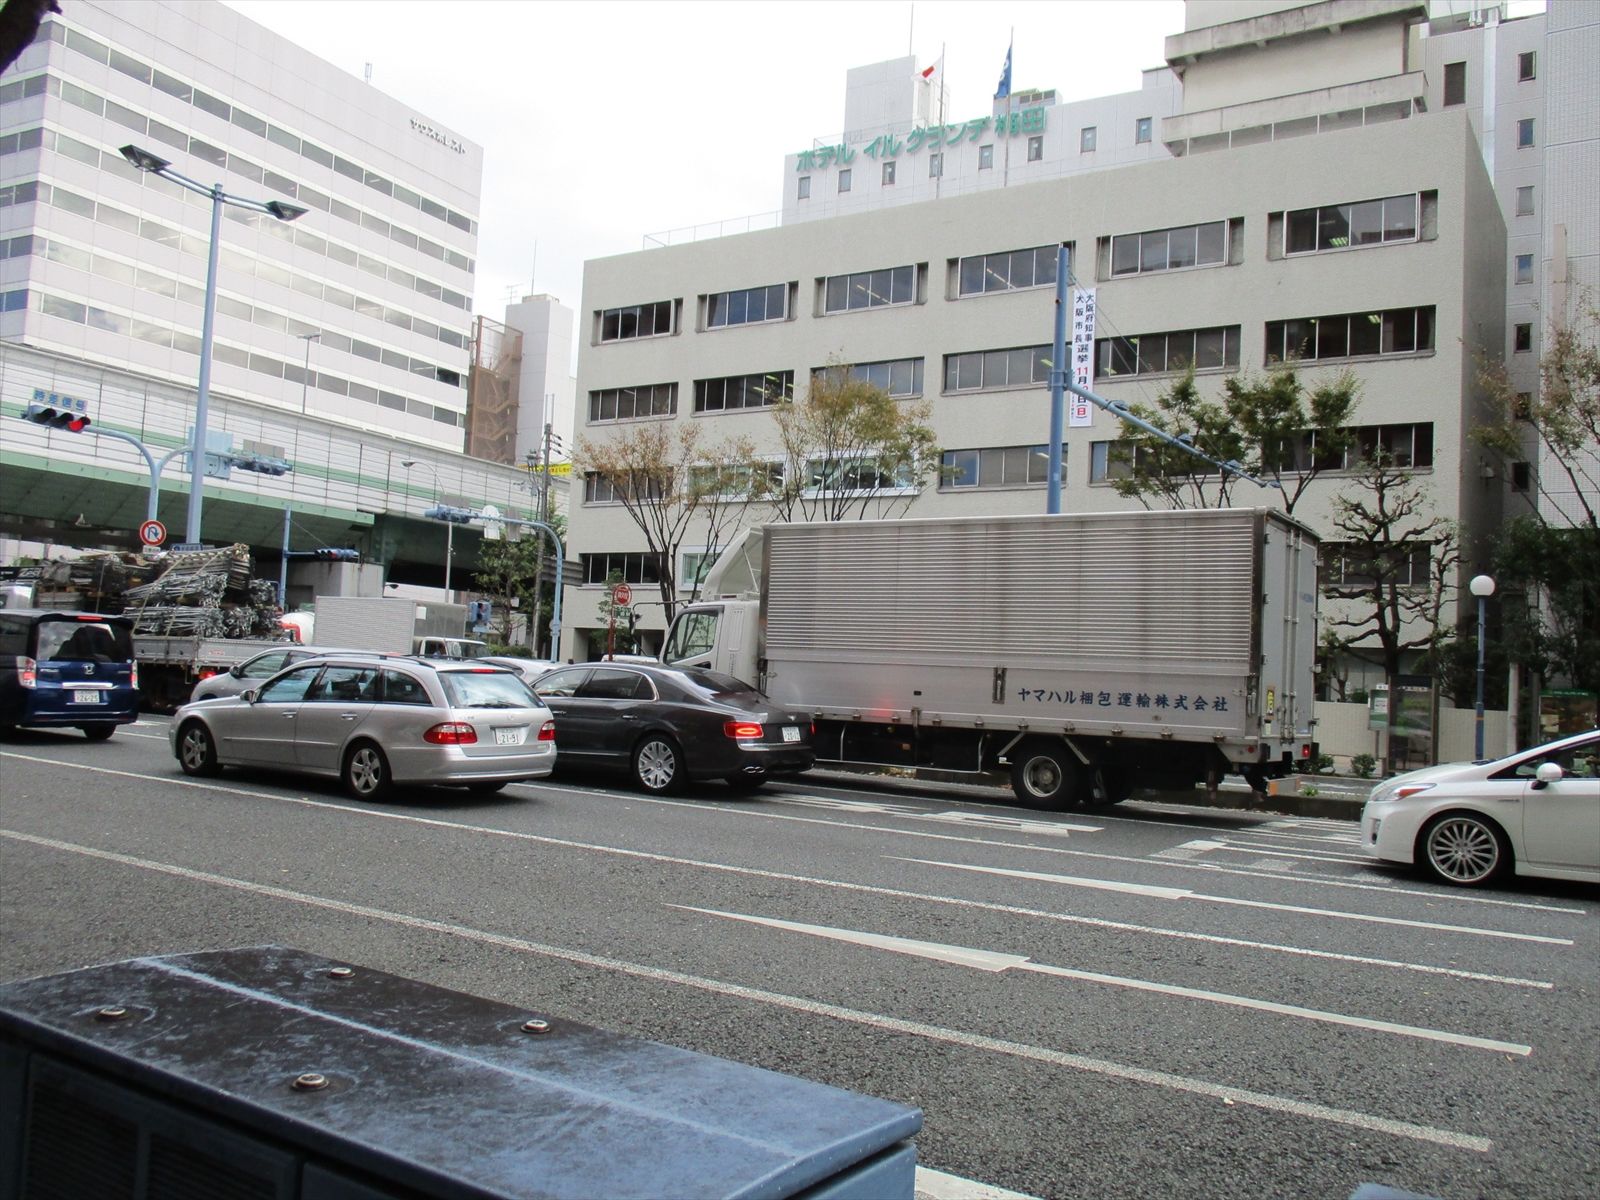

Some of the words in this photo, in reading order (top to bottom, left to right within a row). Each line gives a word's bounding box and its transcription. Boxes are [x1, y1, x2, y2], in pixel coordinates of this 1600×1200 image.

[1075, 295, 1084, 342] 大阪市長
[1085, 294, 1095, 342] 大阪府知事
[1017, 687, 1229, 712] ヤマハル梱包運輸株式会社
